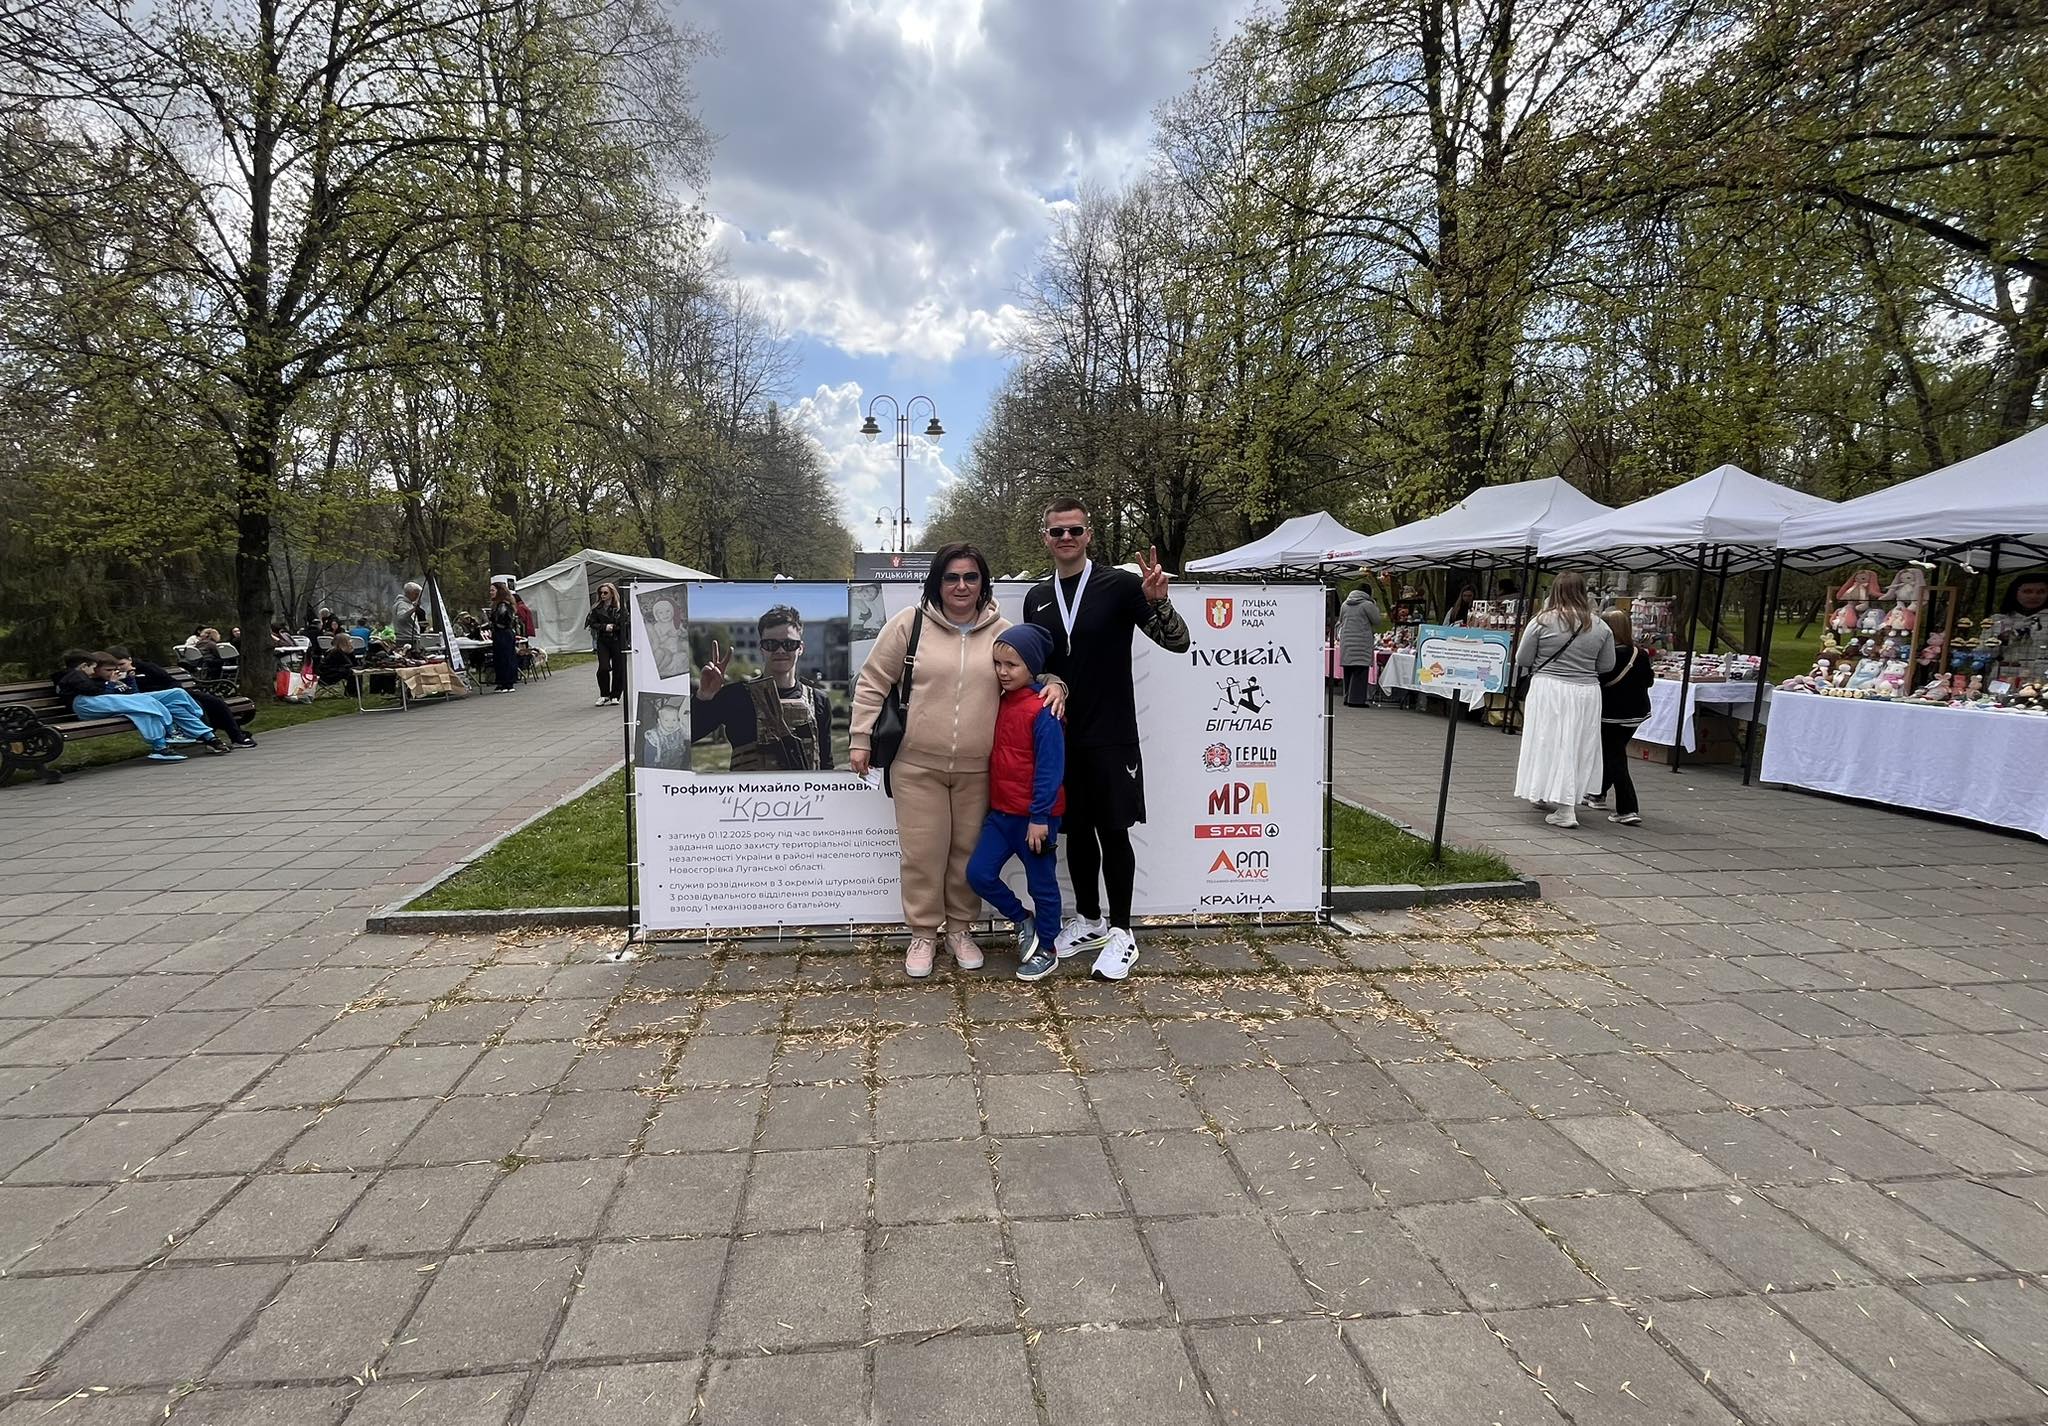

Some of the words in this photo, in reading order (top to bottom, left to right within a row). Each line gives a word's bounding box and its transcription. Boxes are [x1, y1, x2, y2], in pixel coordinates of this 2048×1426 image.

[875, 571, 913, 579] ЛУЦЬКИЙ
[1242, 600, 1277, 608] ЛУЦЬКА
[1242, 609, 1275, 617] МІСЬКА
[1241, 619, 1265, 627] РАДА
[1205, 718, 1273, 732] БІГКЛАБ
[1236, 747, 1277, 761] ГЕРЦЬ
[662, 784, 734, 796] Трофимук
[739, 783, 800, 793] Михайло
[804, 782, 880, 792] Романови
[669, 832, 705, 841] загинув
[708, 831, 751, 839] 01.12.2025
[754, 831, 775, 839] року
[778, 829, 792, 837] під
[1210, 826, 1262, 837] SPAR
[669, 844, 713, 852] завдання
[716, 843, 742, 851] щодо
[744, 843, 779, 851] захисту
[782, 841, 851, 850] територіальної
[854, 840, 898, 848] цілісності
[669, 854, 733, 863] незалежності
[735, 853, 772, 862] України
[783, 852, 814, 861] районі
[817, 852, 870, 860] населеного
[873, 850, 902, 859] пункту
[669, 866, 733, 874] Новоєгорівка
[735, 864, 786, 874] Луганської
[1237, 869, 1268, 878] ХАУС
[670, 882, 704, 890] служив
[707, 880, 767, 889] розвідником
[785, 878, 823, 887] окремій
[826, 877, 875, 887] штурмовій
[878, 876, 901, 885] бриг
[678, 892, 756, 902] розвідувального
[759, 890, 809, 899] відділення
[812, 889, 889, 898] розвідувального
[1201, 892, 1275, 905] КРАЙНА
[670, 905, 702, 913] взводу
[711, 903, 784, 911] механізованого
